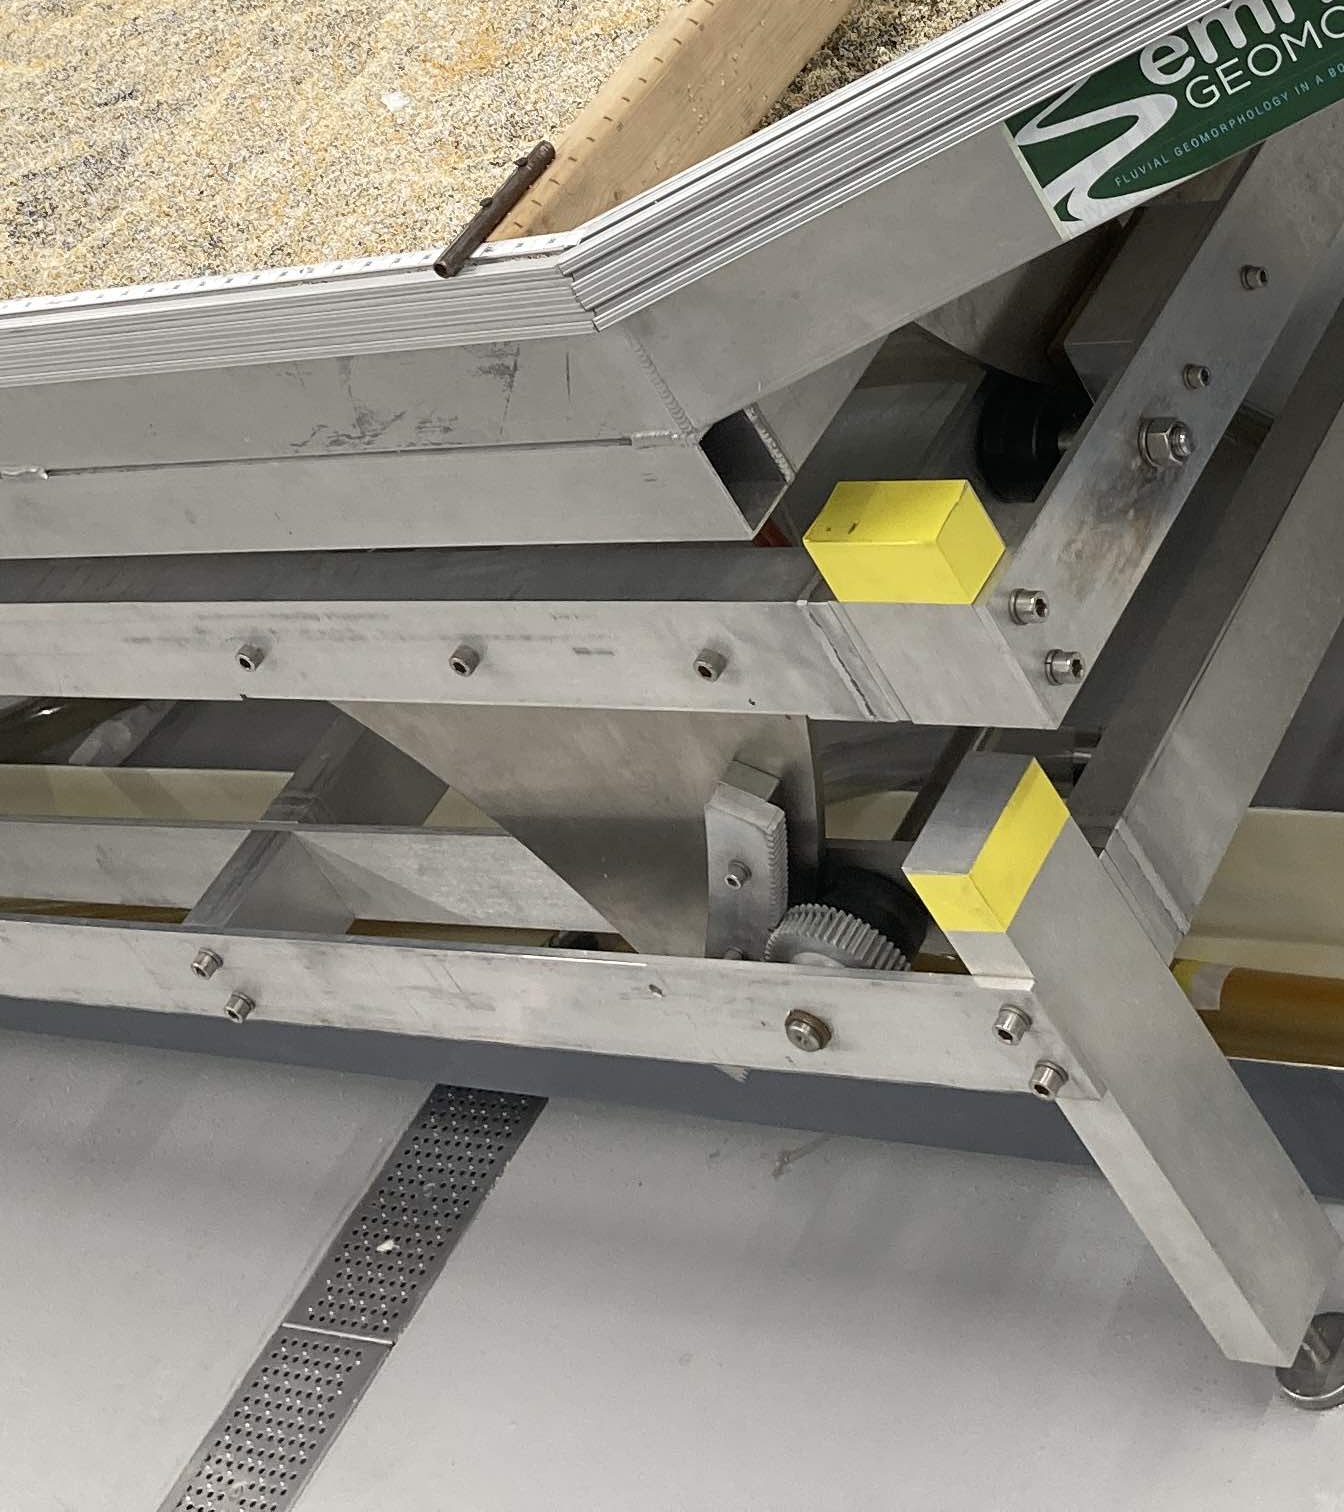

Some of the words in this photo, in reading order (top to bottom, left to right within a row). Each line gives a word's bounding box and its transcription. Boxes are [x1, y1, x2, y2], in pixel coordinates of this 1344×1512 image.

[1114, 155, 1171, 188] FLUVIAL
[1173, 91, 1290, 160] GEOMORPHOLOGY
[1293, 81, 1309, 98] IN
[1314, 72, 1326, 88] A
